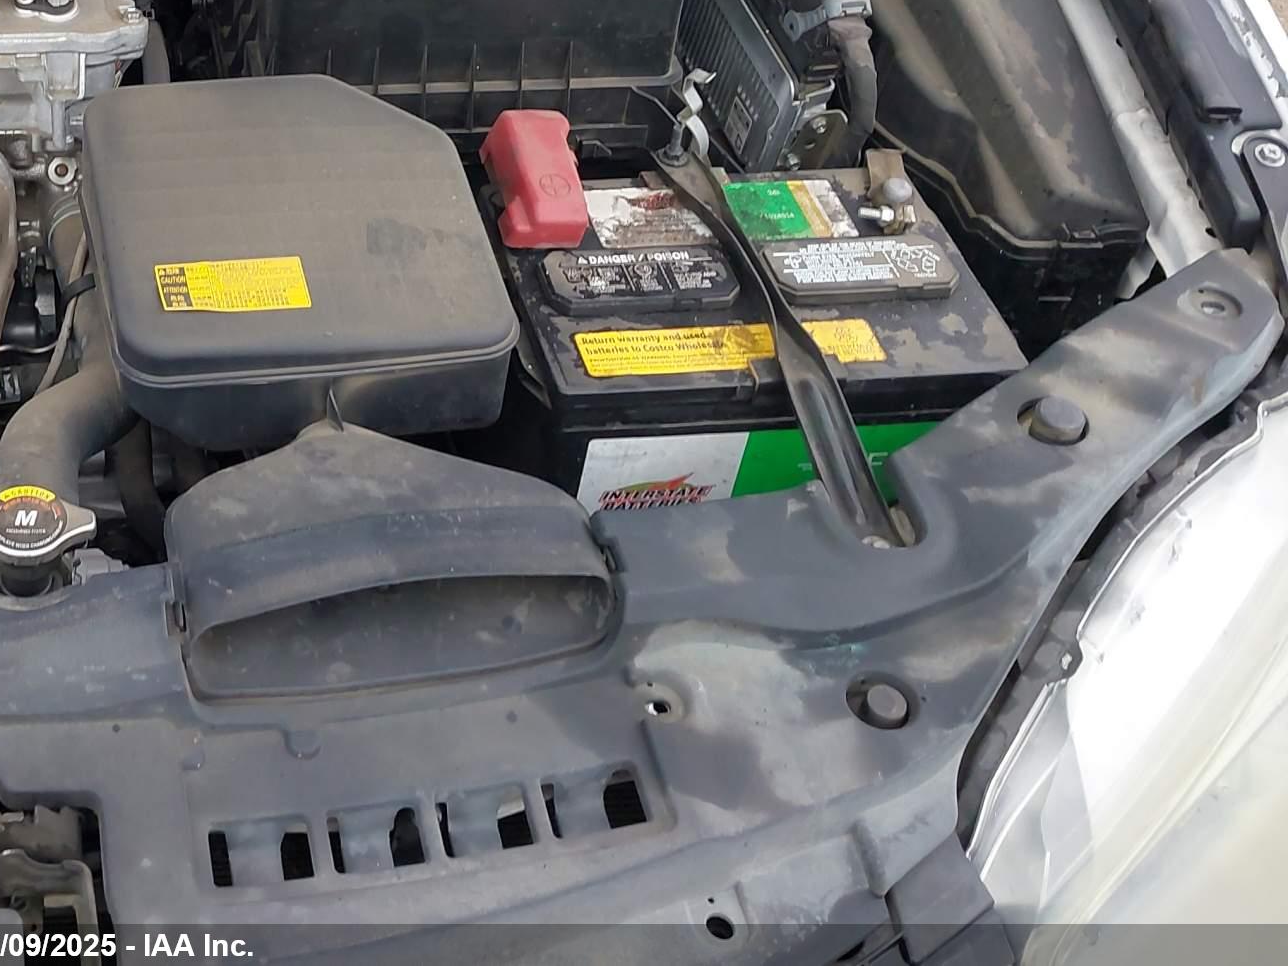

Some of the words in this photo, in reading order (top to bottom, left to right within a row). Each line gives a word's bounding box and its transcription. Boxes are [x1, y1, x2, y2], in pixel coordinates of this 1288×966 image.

[588, 253, 636, 265] DANGER
[646, 250, 690, 262] POISON
[582, 336, 616, 345] Return
[663, 331, 681, 341] and
[683, 329, 707, 340] used
[585, 345, 629, 355] batteries
[631, 345, 642, 353] to
[643, 343, 674, 352] Costco
[599, 483, 716, 503] INTERSTATE
[14, 509, 39, 527] M
